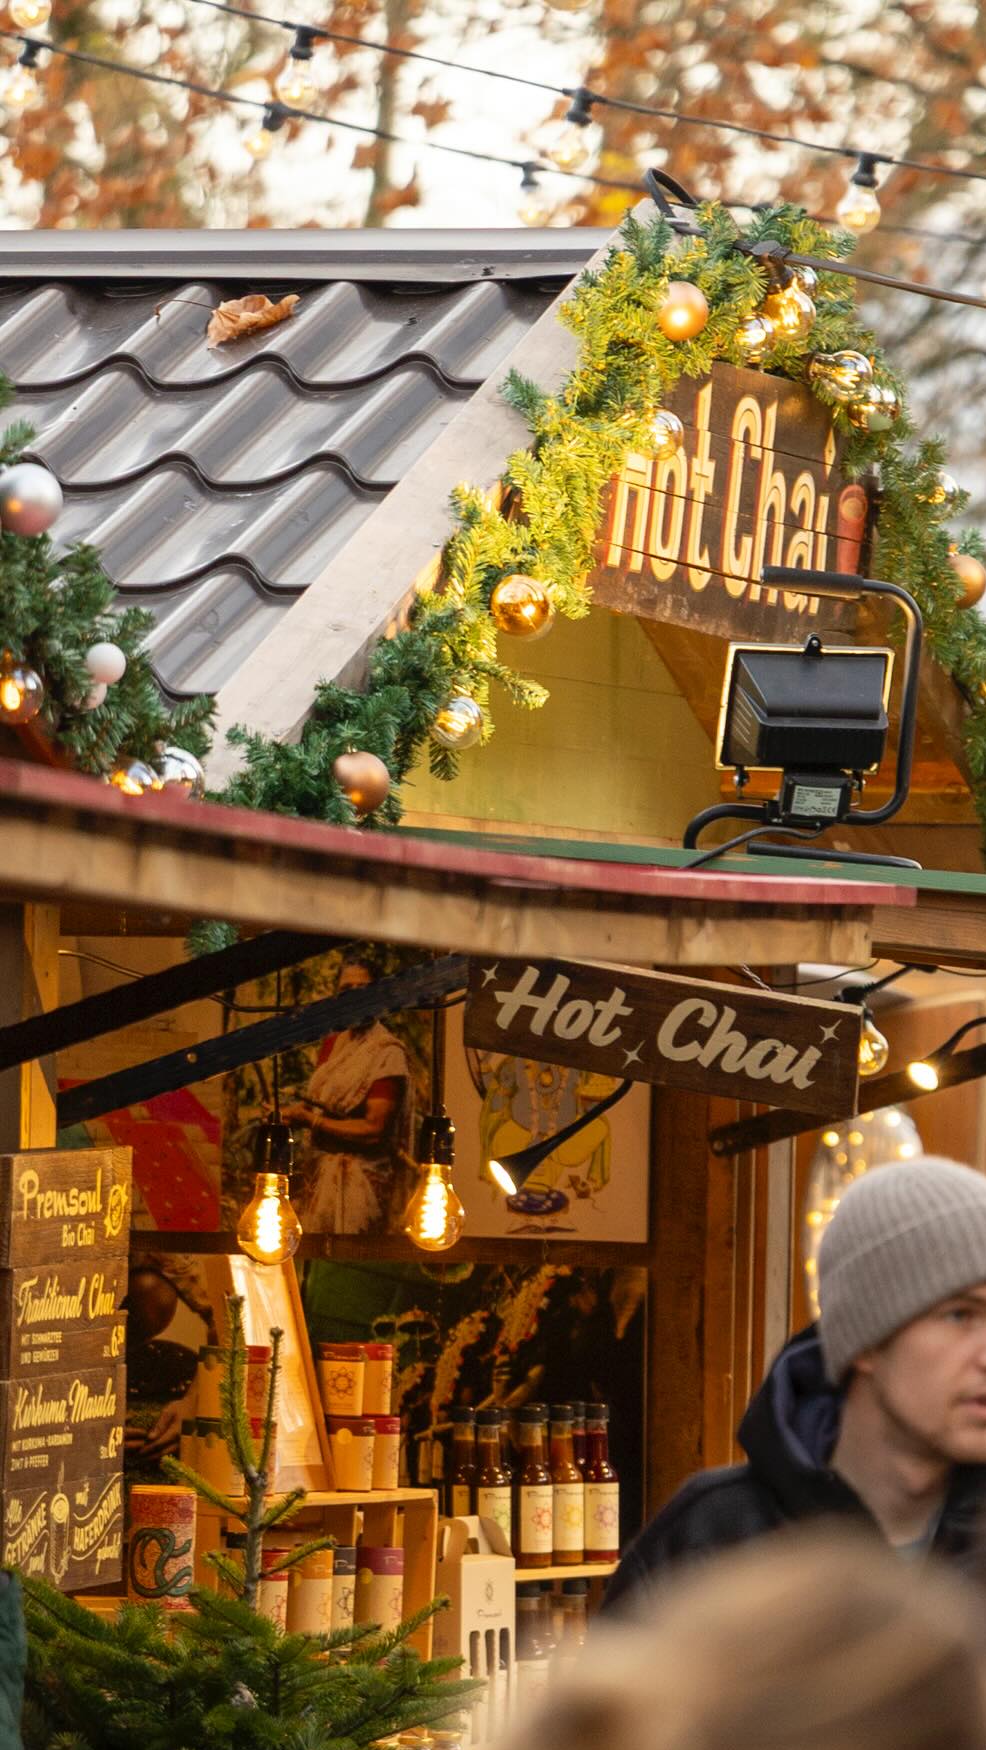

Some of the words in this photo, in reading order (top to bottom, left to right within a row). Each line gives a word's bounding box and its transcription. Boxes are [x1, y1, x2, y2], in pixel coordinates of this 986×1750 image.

[722, 394, 837, 617] Chai
[493, 965, 635, 1048] Hot
[656, 997, 824, 1091] Chai
[20, 1167, 103, 1221] Premsoul
[62, 1224, 76, 1248] Bio
[77, 1220, 96, 1247] Chai
[17, 1274, 87, 1327] Traditional
[88, 1272, 117, 1320] Chai
[20, 1351, 32, 1365] UND
[32, 1346, 60, 1363] GEWÜRZEN
[12, 1383, 68, 1432] Kurkuma
[68, 1377, 117, 1424] Masala
[29, 1453, 49, 1468] PFEFFER
[5, 1502, 48, 1567] GETRÄNKE
[73, 1481, 122, 1552] HAFERDRINK
